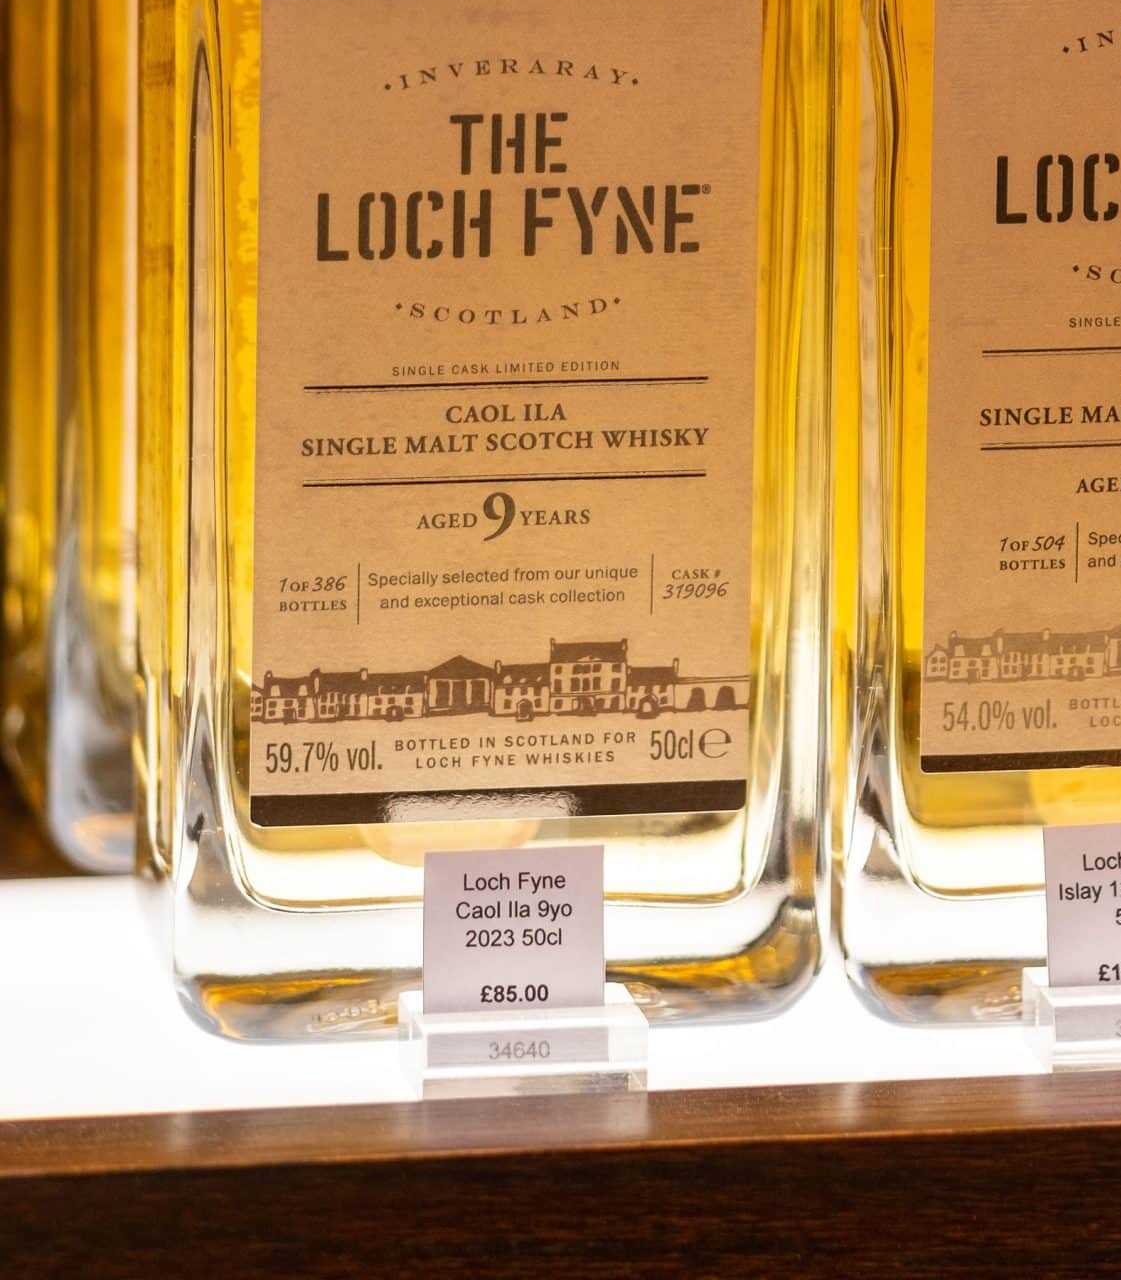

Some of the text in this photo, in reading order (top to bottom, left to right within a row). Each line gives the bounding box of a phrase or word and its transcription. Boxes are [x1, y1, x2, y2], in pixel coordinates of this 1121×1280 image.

[399, 58, 629, 91] INVERARAY
[449, 111, 569, 176] THE
[316, 188, 492, 262] LOCH
[409, 298, 608, 326] SCOTLAND
[1068, 315, 1121, 329] SINGLE
[391, 359, 620, 377] SINGLE CASK LIMITED EDITION
[445, 402, 567, 424] CAOL ILA
[979, 406, 1073, 427] SINGLE
[300, 427, 710, 457] SINGLE MALT SCOTCH WHISKY
[415, 491, 591, 542] AGED 9 YEARS
[999, 558, 1066, 572] BOTTLES
[1087, 553, 1117, 569] and
[367, 567, 639, 590] Specially selected from our unique
[671, 568, 710, 581] CASK
[279, 599, 348, 613] BOTTLES
[379, 588, 625, 611] and exceptional cask collection
[1021, 697, 1058, 730] vol.
[394, 731, 636, 752] BOTTLED IN SCOTLAND FOR
[649, 728, 694, 761] 50cl
[265, 739, 383, 774] 59.7% vol.
[415, 750, 615, 769] LOCH FYNE WHISKIES
[463, 871, 566, 895] Loch Fyne
[1058, 881, 1103, 904] Islay
[455, 900, 501, 920] Caol
[537, 899, 573, 922] 9yo
[465, 927, 562, 948] 2023 50cl
[480, 983, 549, 1004] £85.00
[488, 1039, 551, 1060] 34640
